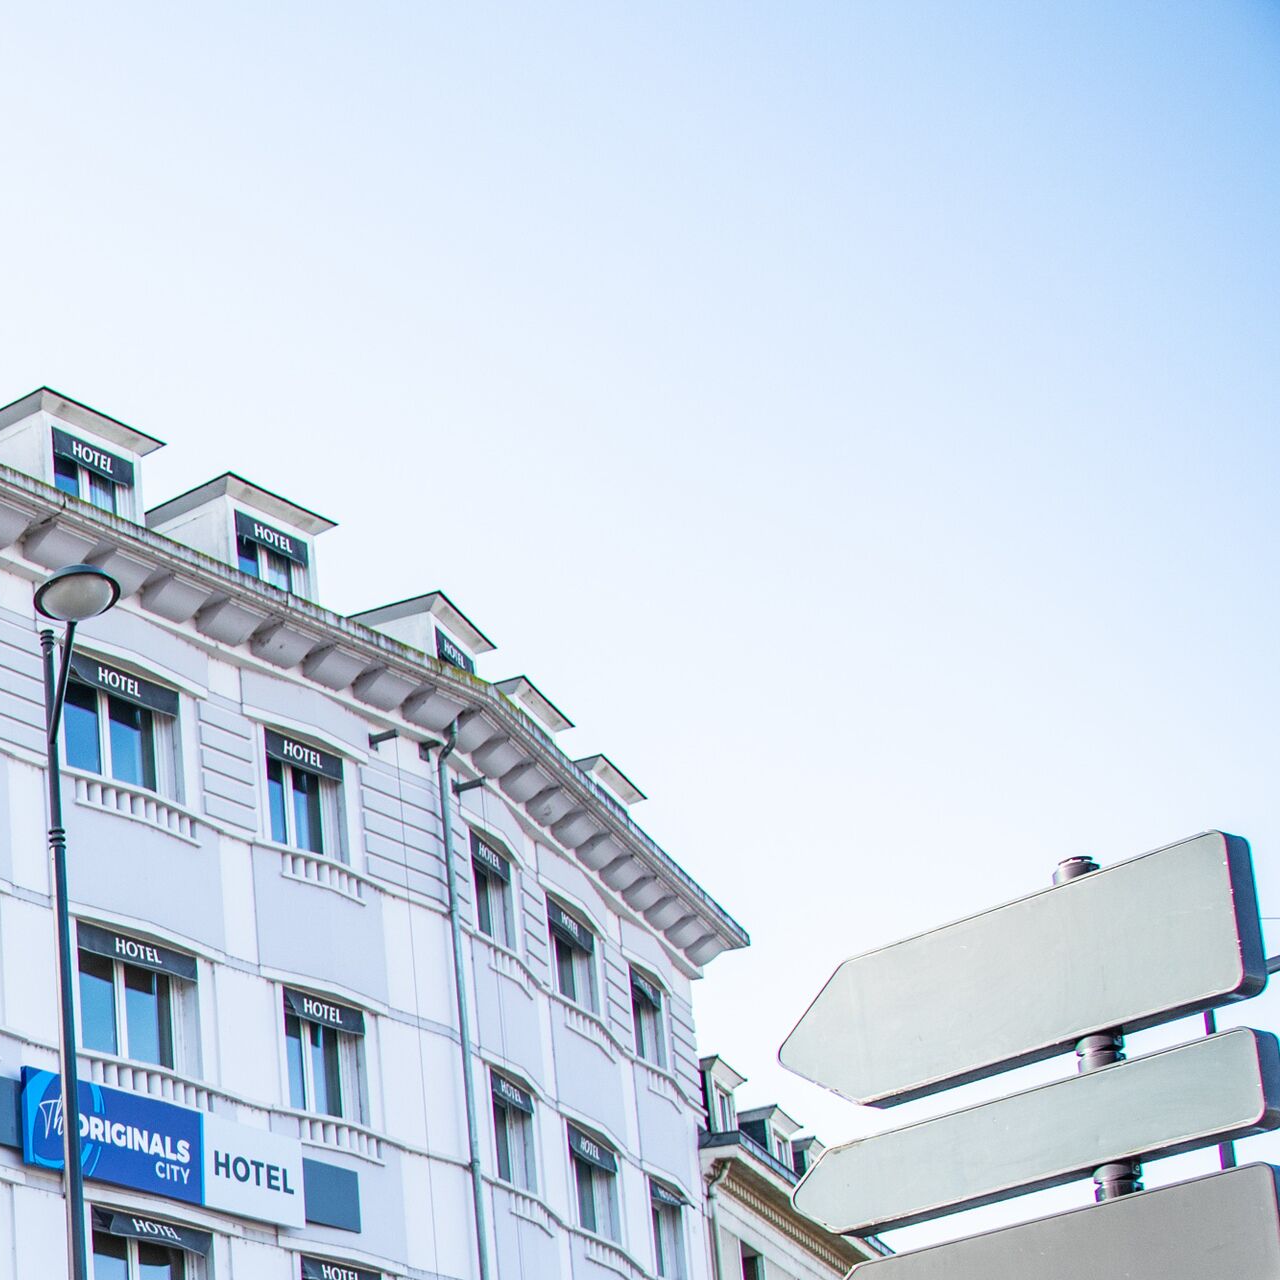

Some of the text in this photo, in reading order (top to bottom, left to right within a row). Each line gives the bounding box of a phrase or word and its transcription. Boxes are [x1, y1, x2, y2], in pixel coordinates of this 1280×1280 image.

[72, 440, 113, 475] HOTEL
[254, 523, 292, 553] HOTEL
[443, 639, 466, 669] HOTEL
[98, 665, 141, 698] HOTEL
[283, 739, 323, 769] HOTEL
[478, 843, 501, 870] HOTEL
[115, 937, 162, 964] HOTEL
[303, 997, 343, 1025] HOTEL
[39, 1094, 64, 1139] Th
[155, 1162, 190, 1185] CITY
[214, 1150, 295, 1195] HOTEL
[132, 1216, 182, 1244] HOTEL
